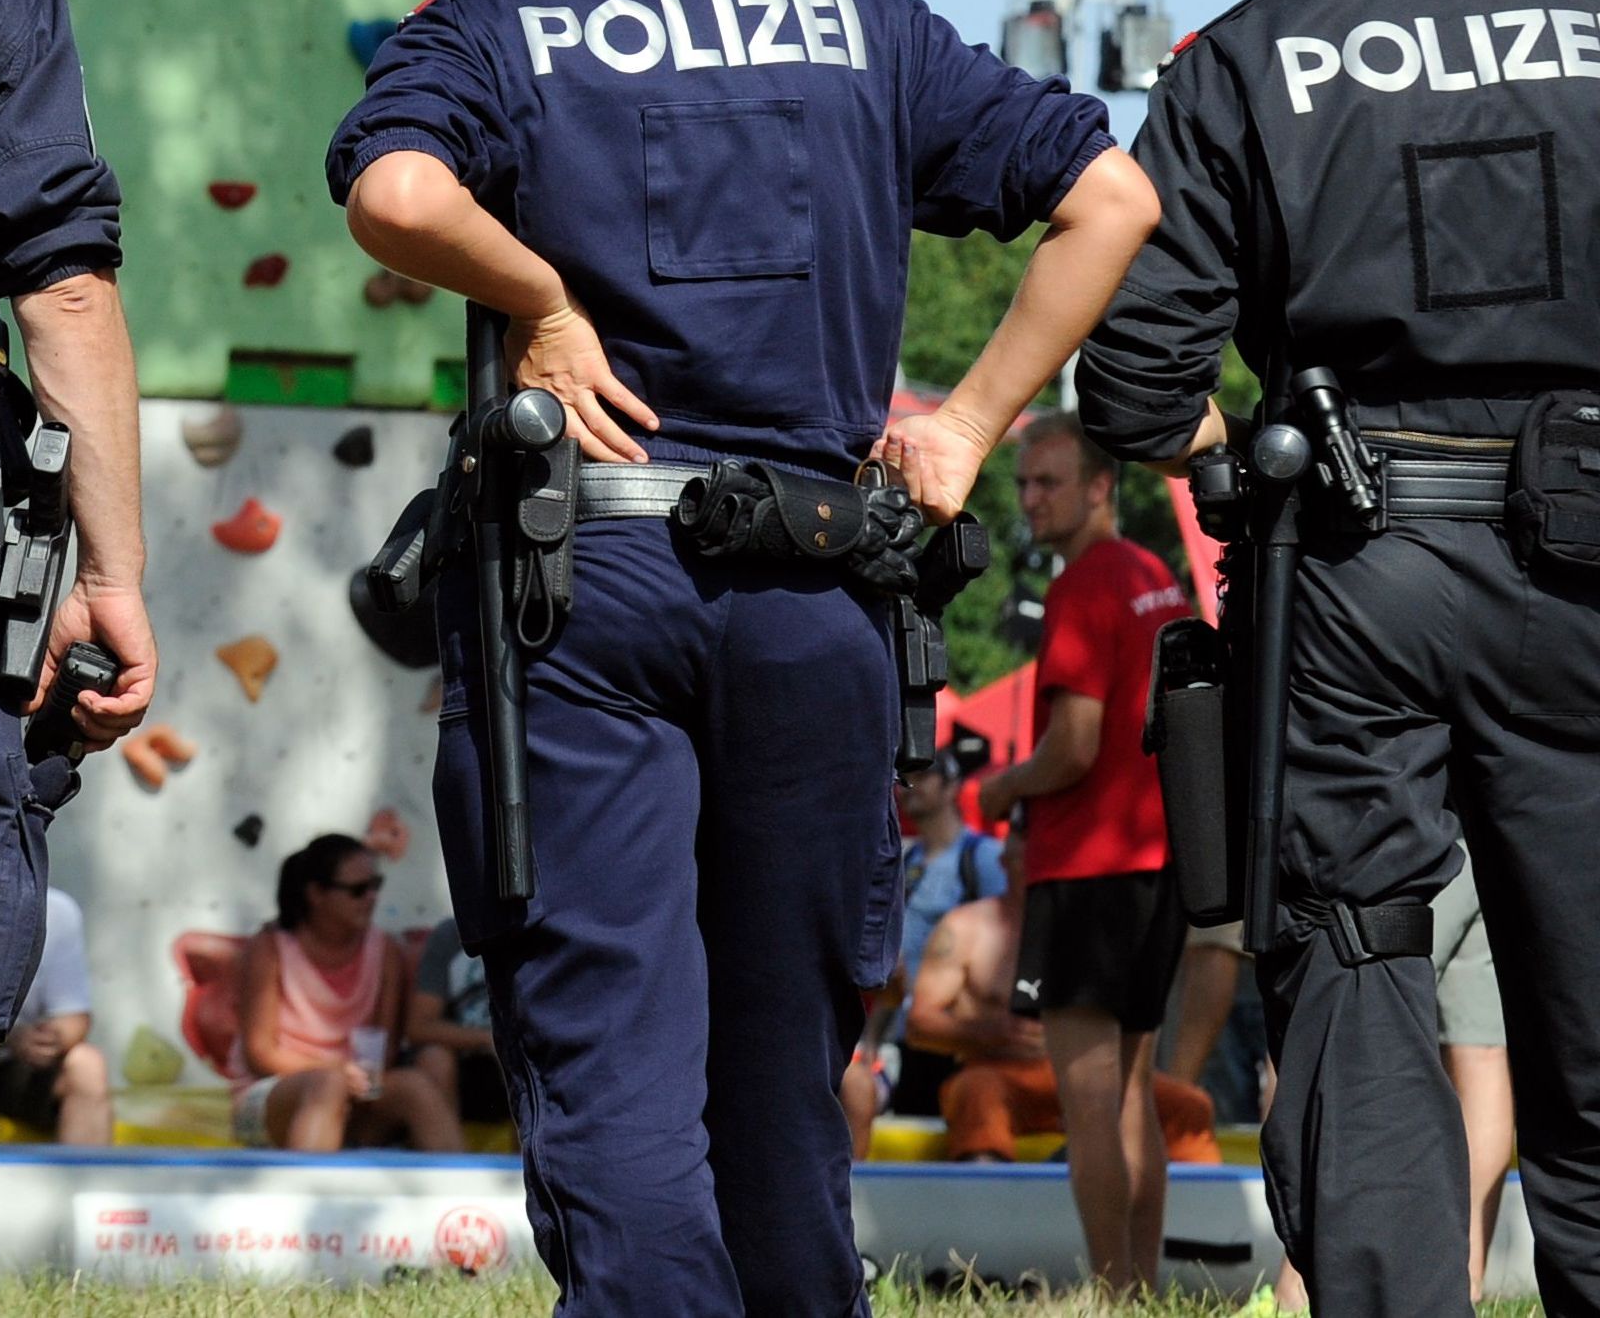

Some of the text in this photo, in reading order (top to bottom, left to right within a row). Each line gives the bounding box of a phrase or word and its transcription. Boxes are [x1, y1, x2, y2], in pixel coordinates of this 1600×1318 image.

[1275, 8, 1600, 115] POLIZE
[96, 1230, 179, 1259] Wien
[195, 1227, 344, 1259] bewegen
[357, 1233, 414, 1260] Wir
